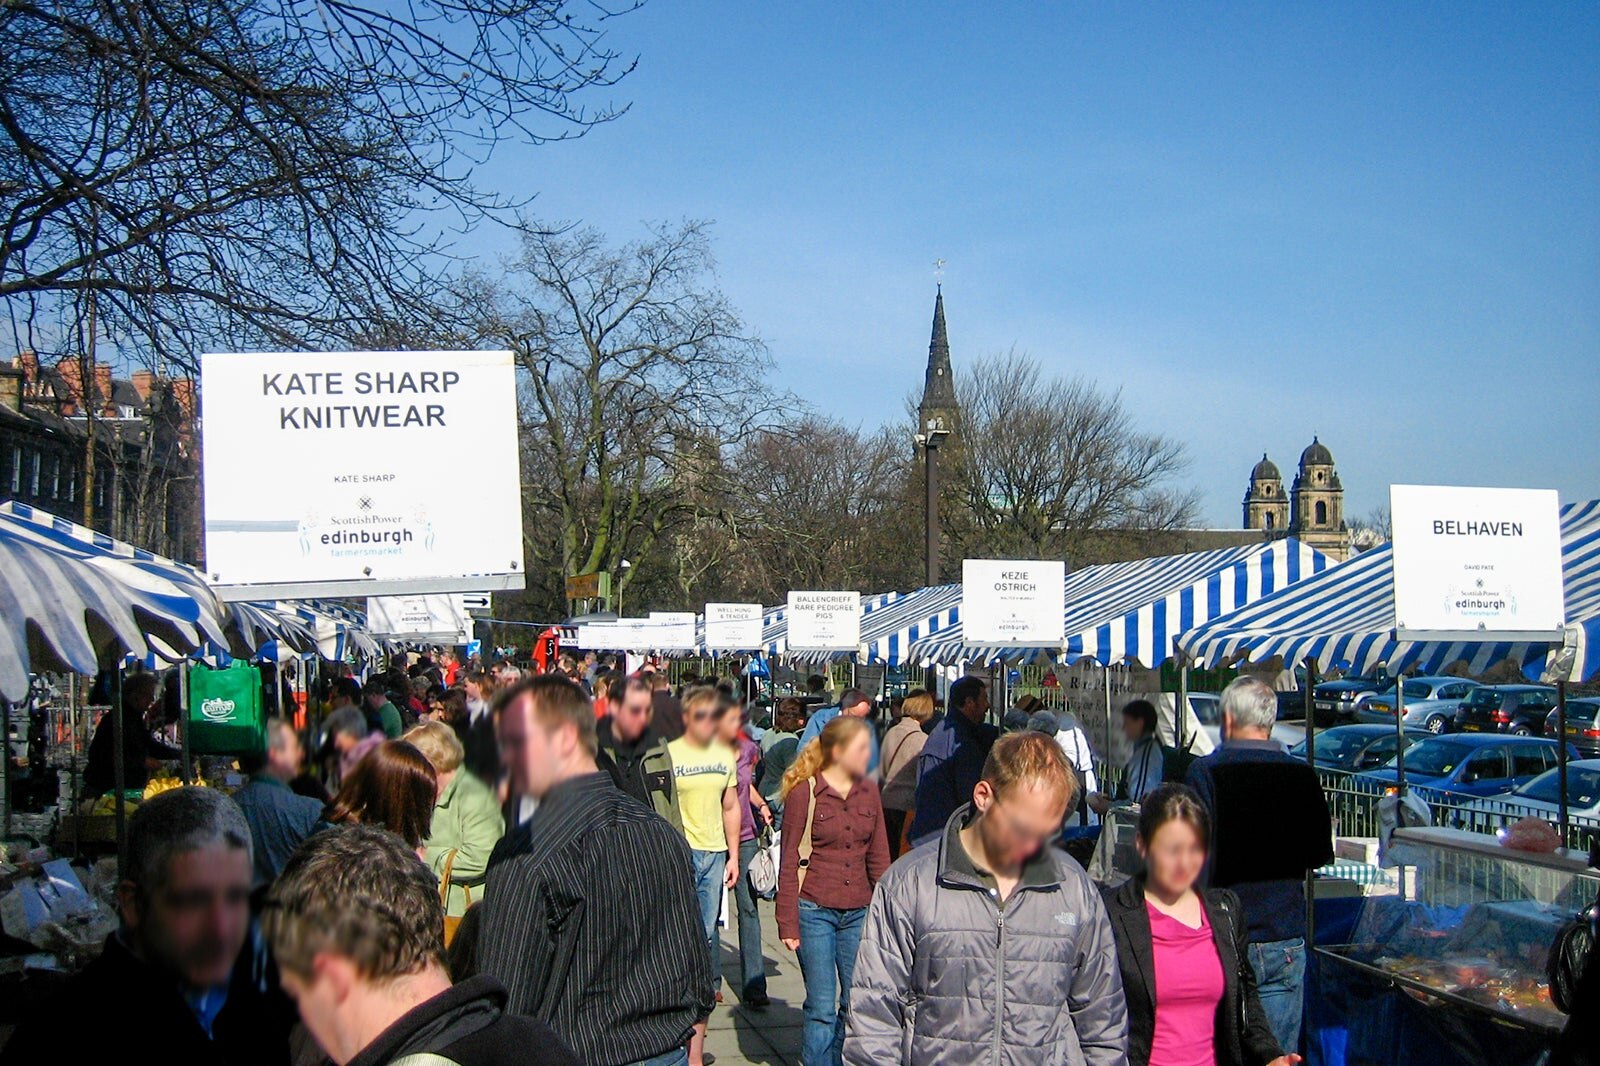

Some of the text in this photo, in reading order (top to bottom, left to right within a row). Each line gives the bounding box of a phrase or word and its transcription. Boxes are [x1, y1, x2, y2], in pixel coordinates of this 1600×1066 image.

[263, 371, 460, 396] KATE SHARP
[280, 405, 446, 430] KNITWEAR
[333, 473, 396, 483] KATE SHARP
[1433, 520, 1523, 537] BELHAVEN
[321, 528, 413, 546] edinburgh
[330, 547, 403, 558] farmersmarket
[1001, 571, 1029, 581] KEZIE
[994, 582, 1036, 592] OSTRICH
[796, 595, 852, 603] BALLENCRIEFF
[1455, 599, 1506, 610] edinburgh
[815, 612, 833, 620] PIGS
